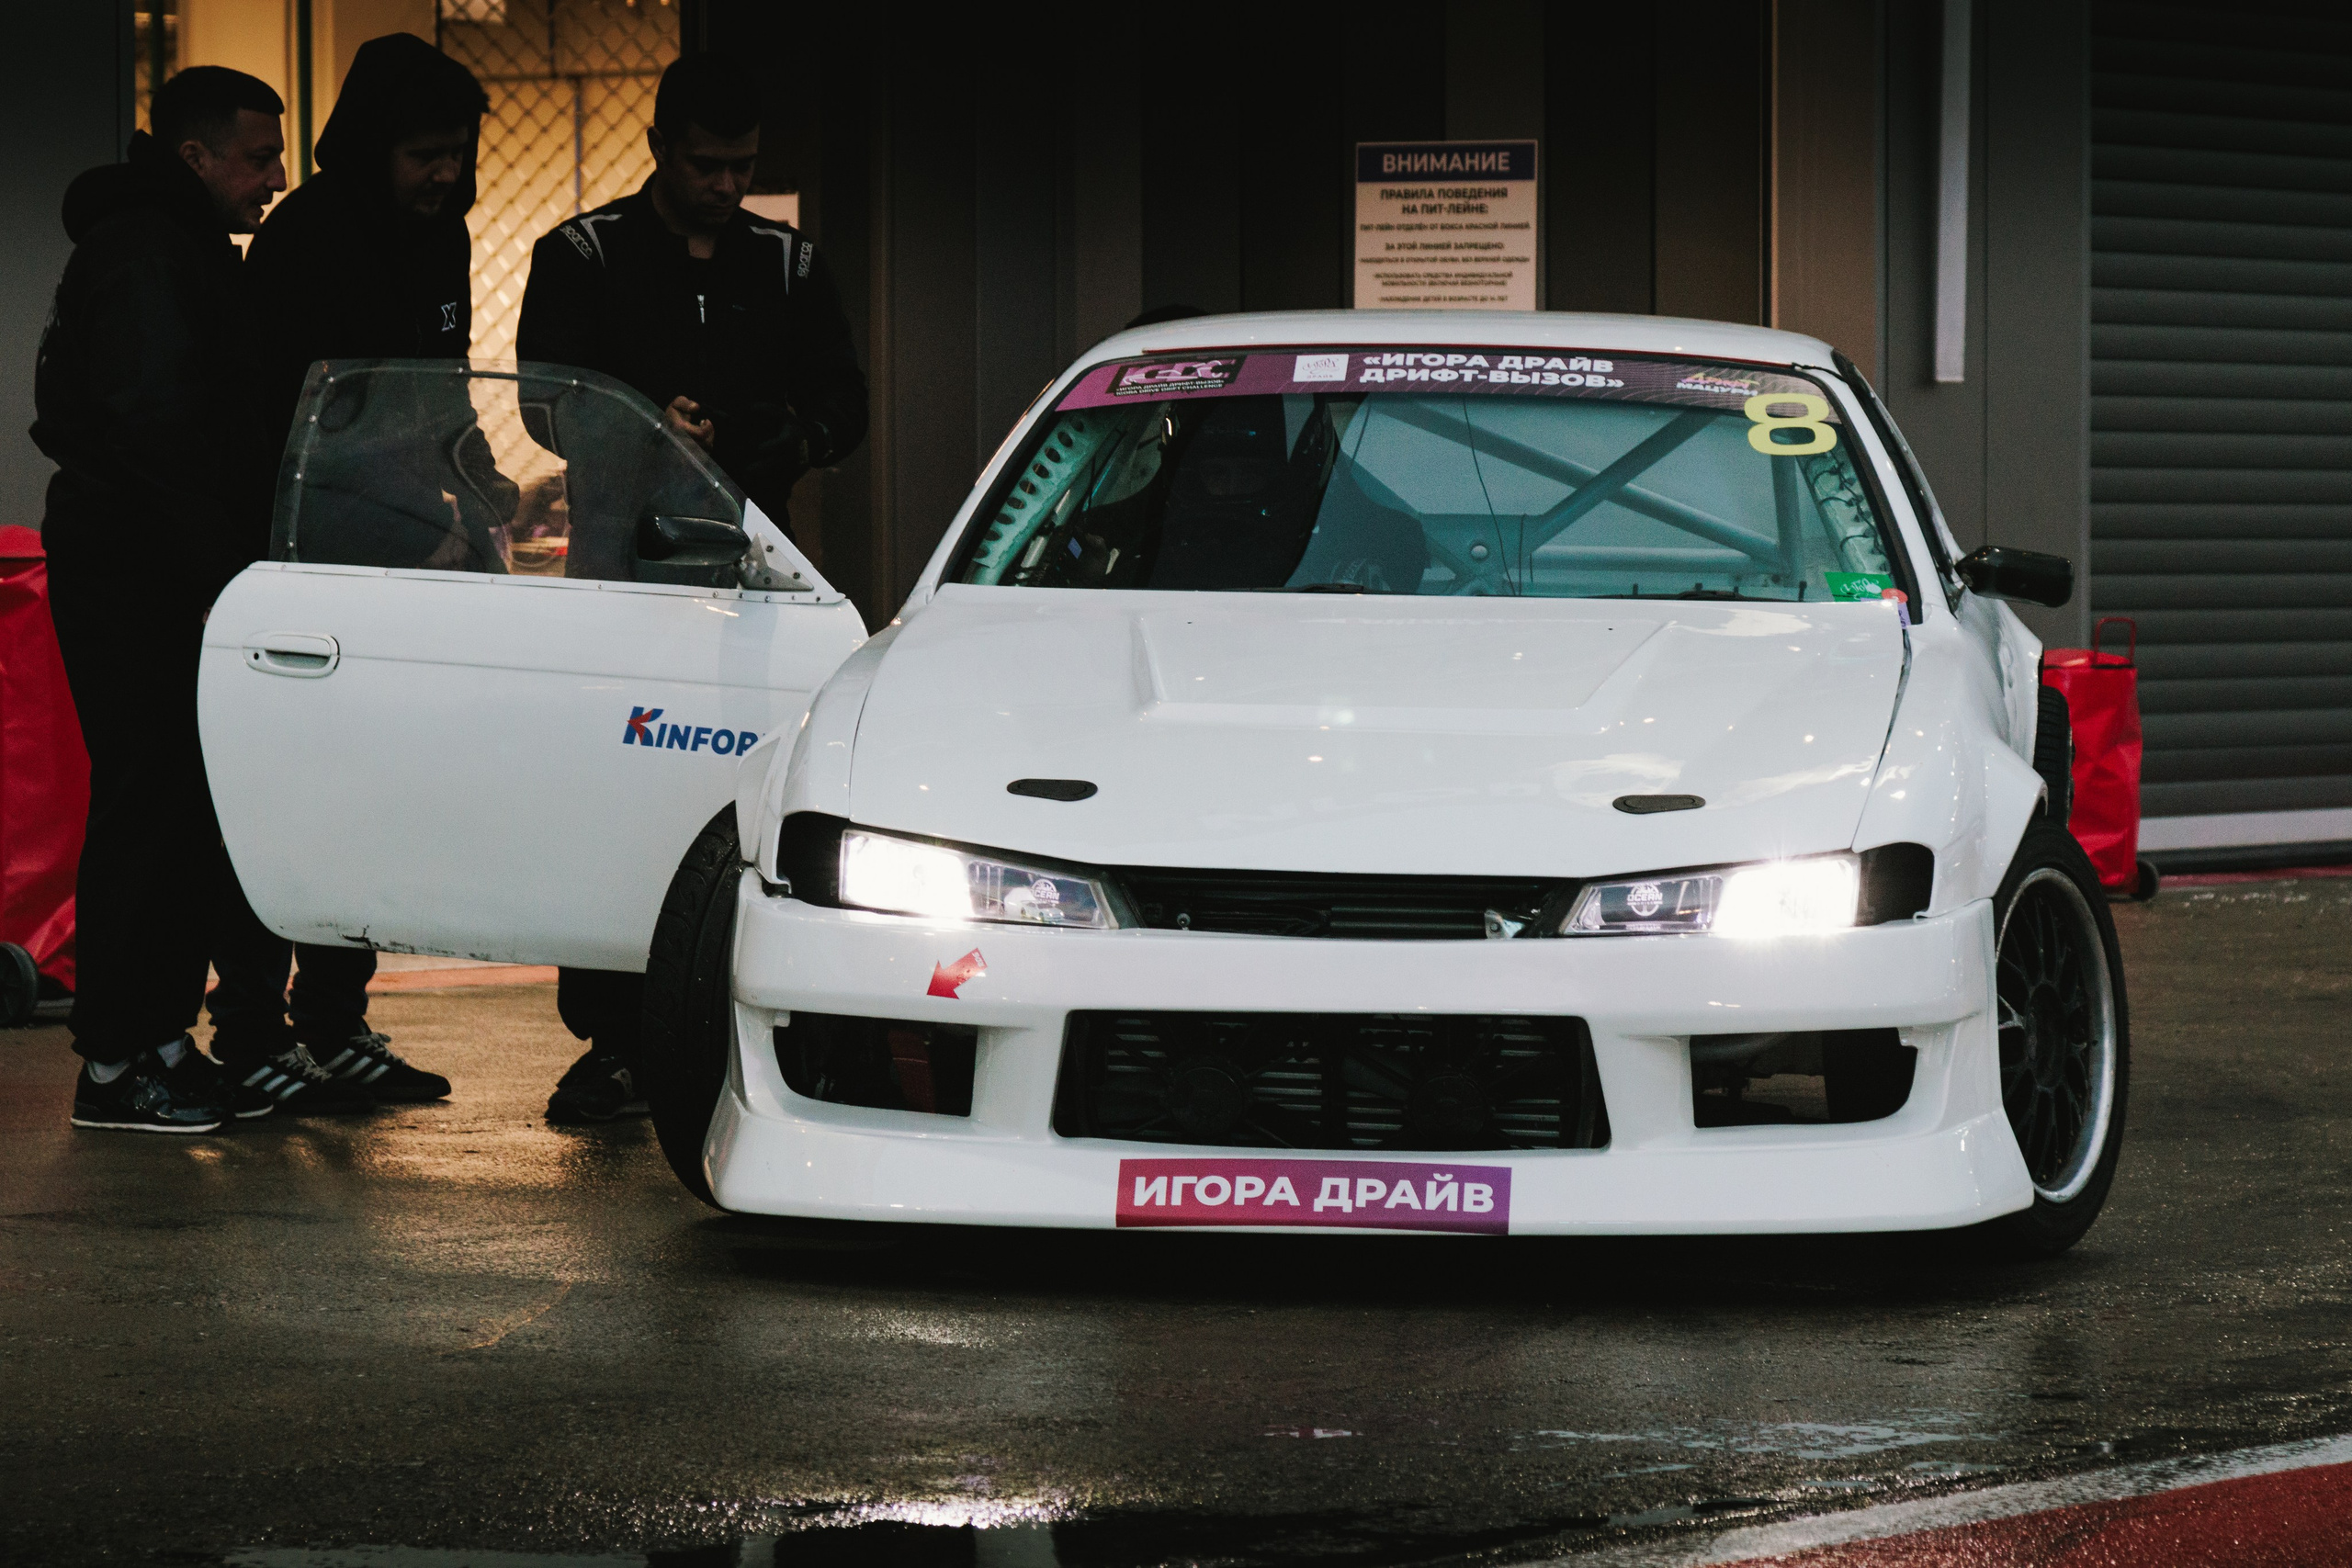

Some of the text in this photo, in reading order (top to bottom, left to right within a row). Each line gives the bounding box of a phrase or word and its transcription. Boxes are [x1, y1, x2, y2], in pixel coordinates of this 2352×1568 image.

[1383, 152, 1510, 173] ВНИМАНИЕ
[1381, 187, 1508, 200] ПРАВИЛА ПОВЕДЕНИЯ
[1402, 204, 1418, 214] НА
[797, 242, 812, 277] sparco
[1363, 353, 1614, 372] «ИГОРА ДРАЙВ
[1359, 368, 1624, 388] ДРИФТ-ВЫЗОВ»
[1744, 392, 1838, 456] 8
[622, 705, 766, 757] KINFOR
[1627, 892, 1663, 902] OCEAN
[1133, 1172, 1496, 1213] ИГОРА ДРАЙВ
